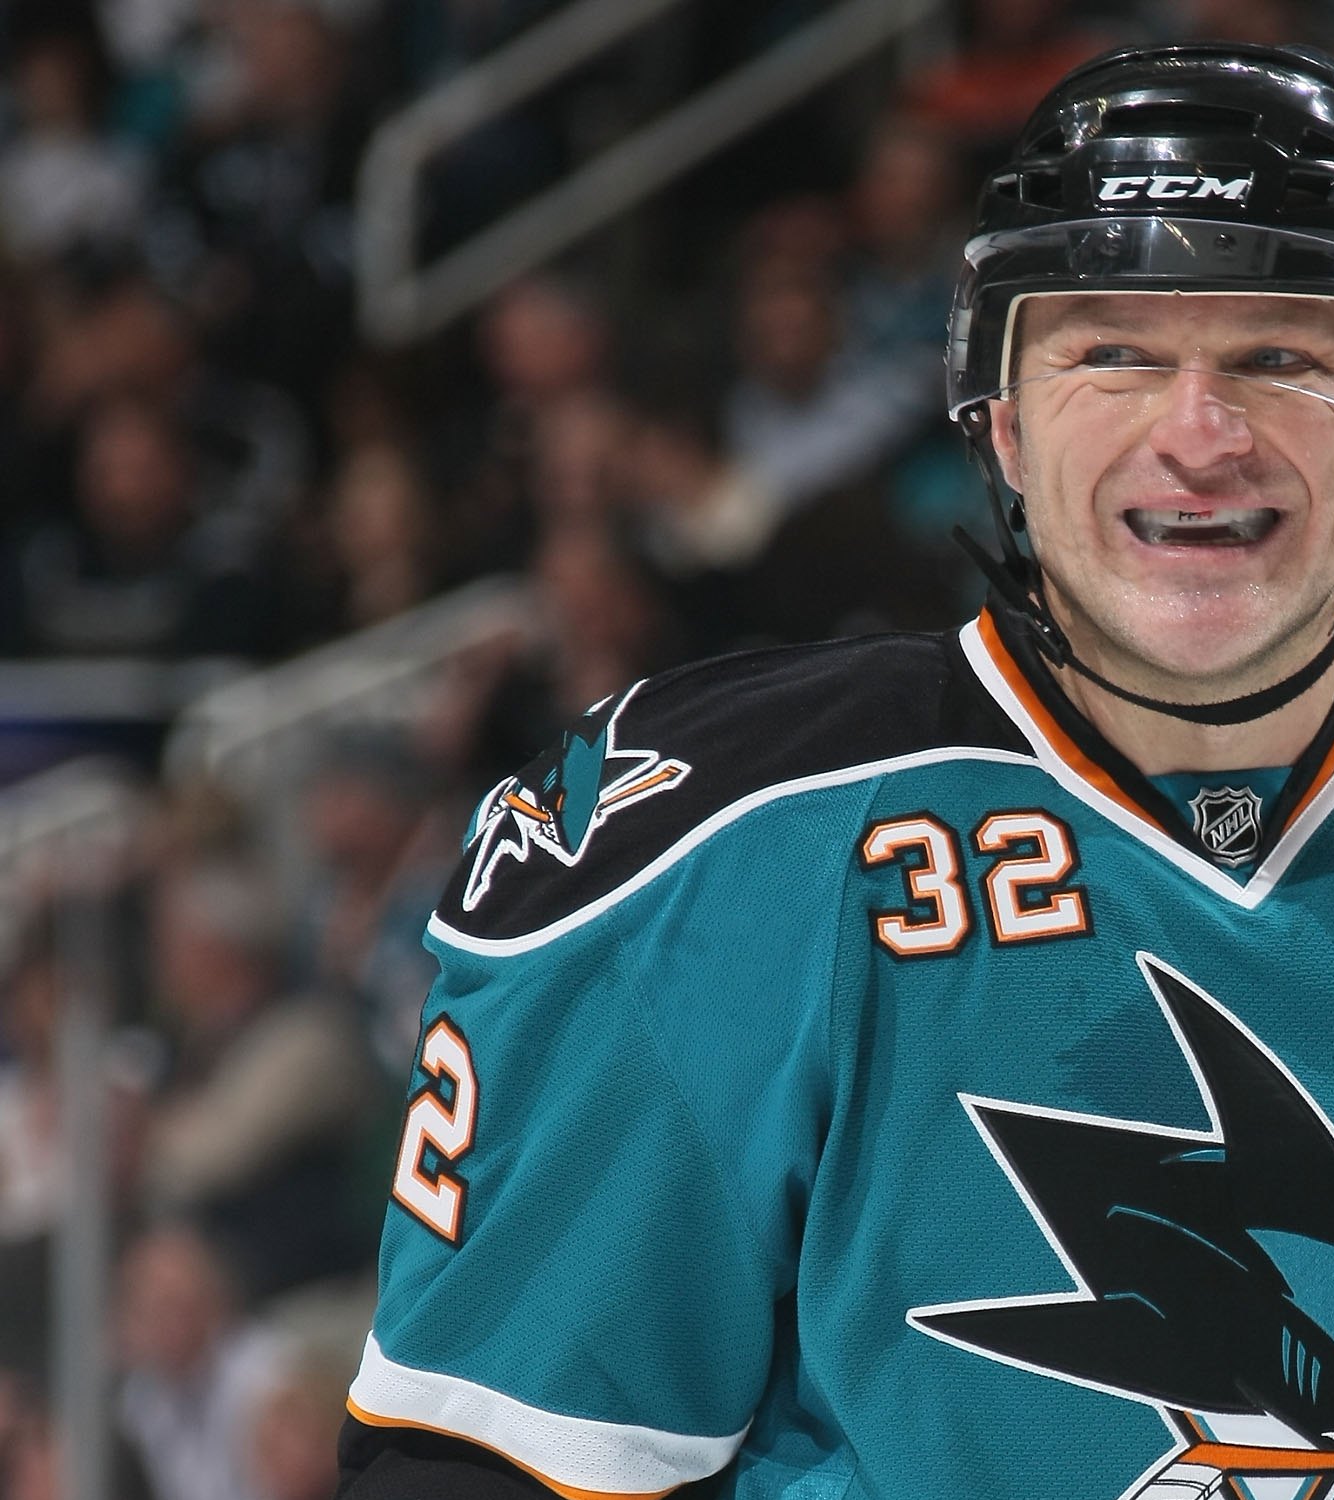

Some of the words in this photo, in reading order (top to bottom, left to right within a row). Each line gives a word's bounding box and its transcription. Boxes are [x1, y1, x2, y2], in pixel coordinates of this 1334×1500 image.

[1099, 174, 1250, 201] CCM
[1210, 806, 1250, 849] NHL
[860, 808, 1095, 961] 32
[392, 1013, 479, 1249] 2
